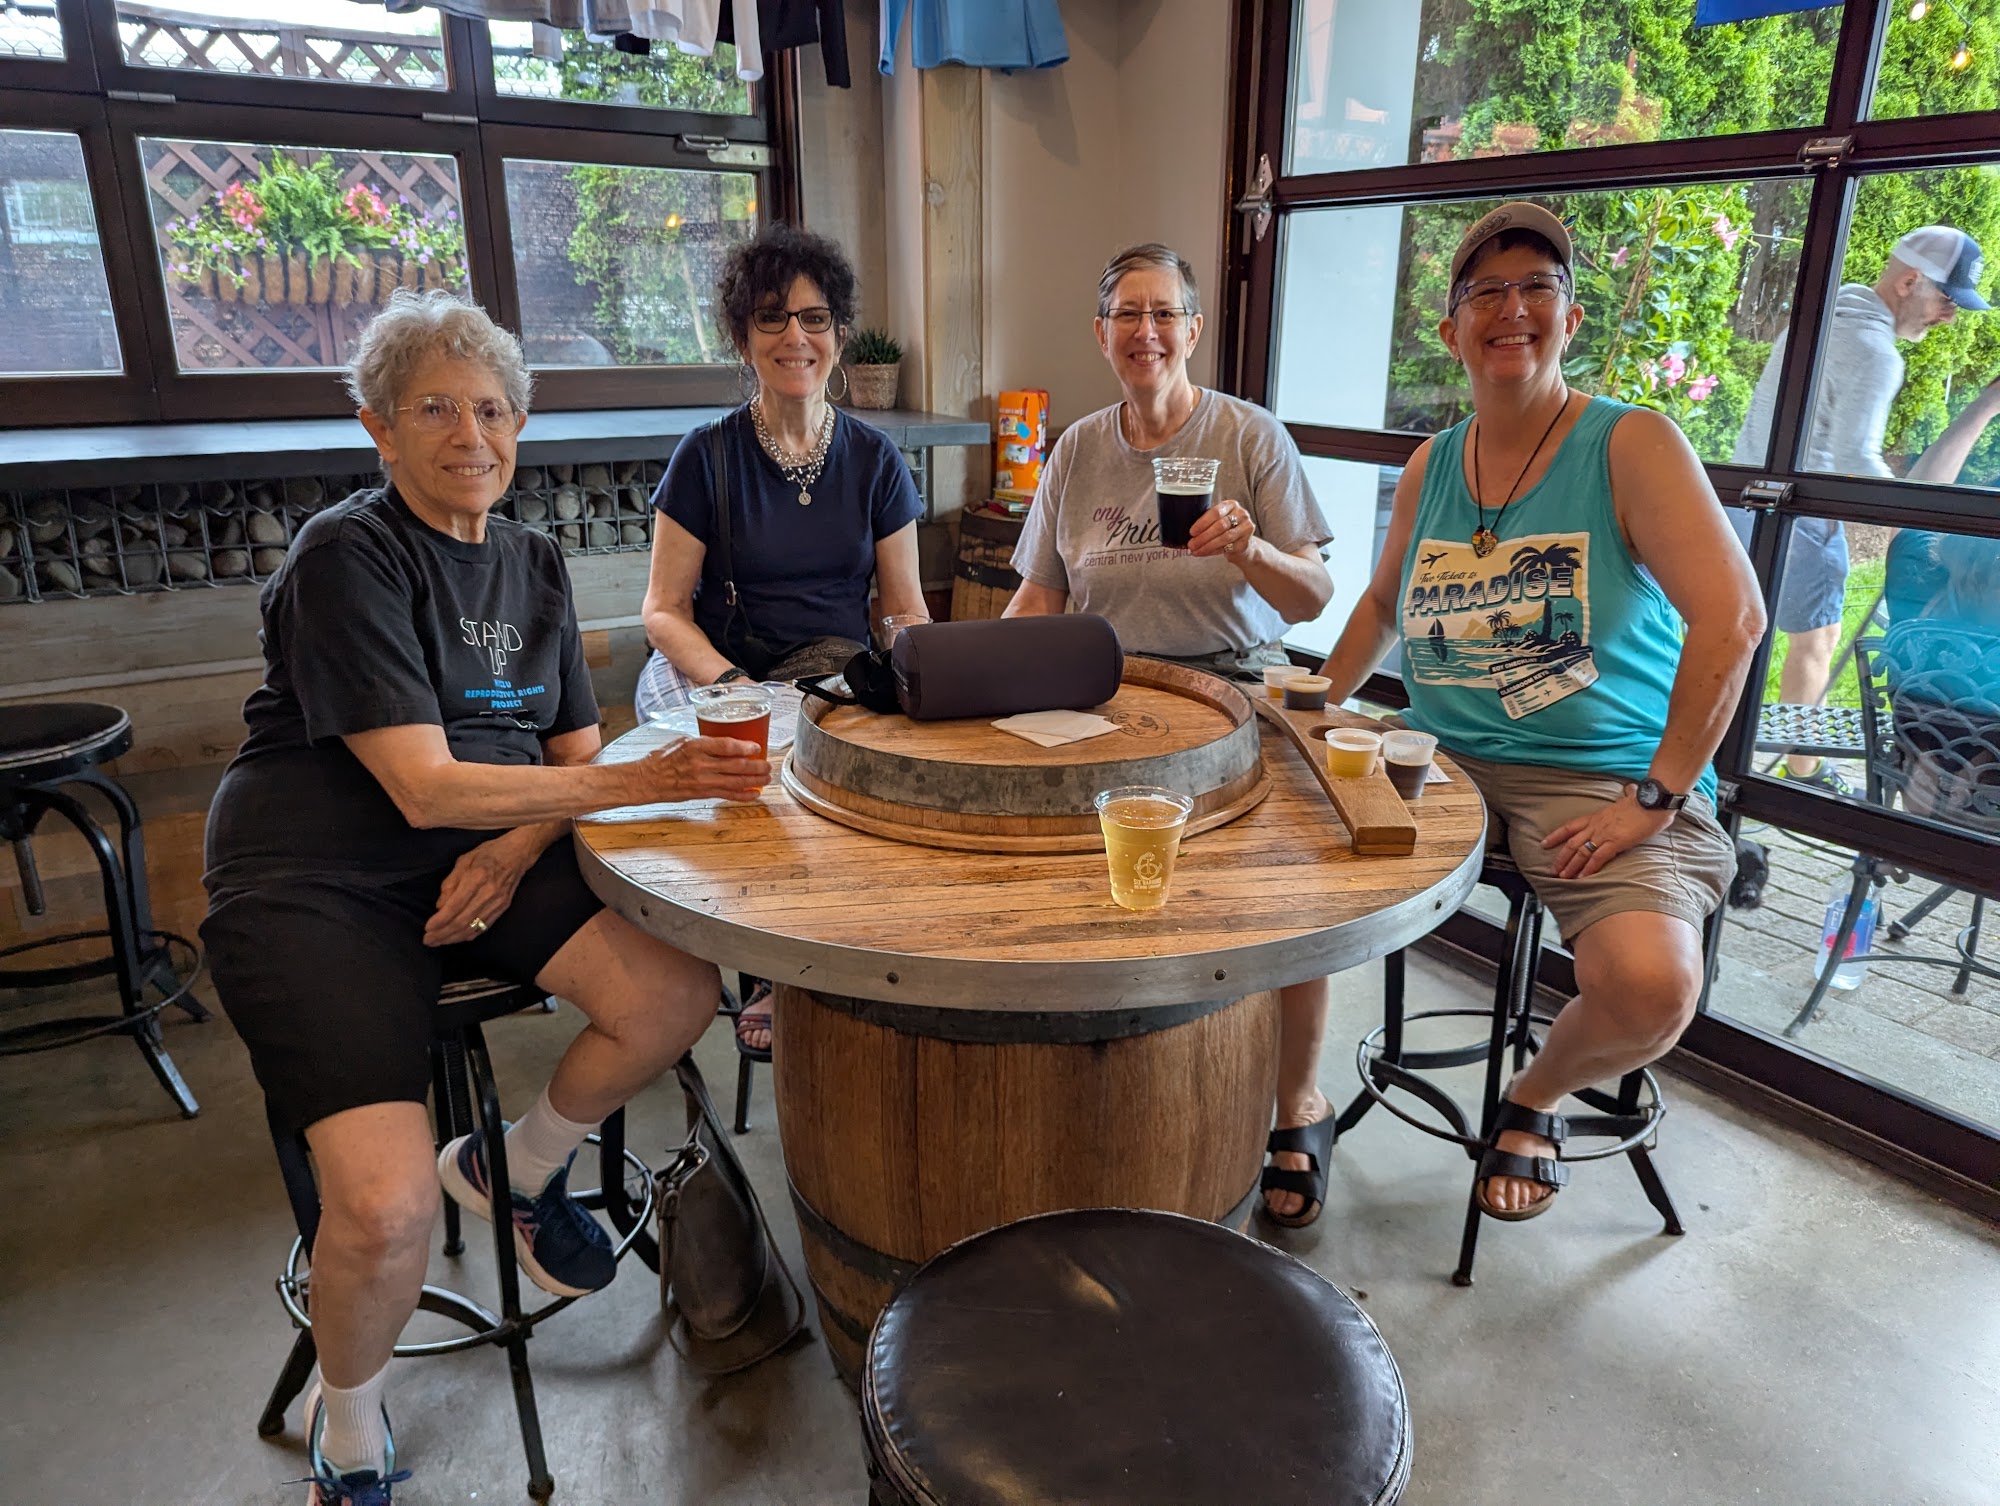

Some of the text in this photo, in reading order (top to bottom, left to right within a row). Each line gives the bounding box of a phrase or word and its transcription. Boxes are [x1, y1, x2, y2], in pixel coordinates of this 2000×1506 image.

[1105, 516, 1162, 547] Pri
[1084, 551, 1117, 567] central
[1120, 553, 1143, 565] new
[1146, 548, 1169, 563] york
[1420, 572, 1434, 583] Two
[1437, 571, 1467, 581] Tickets
[1409, 565, 1574, 618] PARADISE
[459, 617, 523, 651] STAND
[488, 645, 507, 676] UP
[1505, 658, 1538, 668] CHECKLIST
[517, 685, 545, 696] RIGHTS
[1500, 670, 1550, 696] CLASSROOM KEYS
[491, 699, 523, 708] PROJECT
